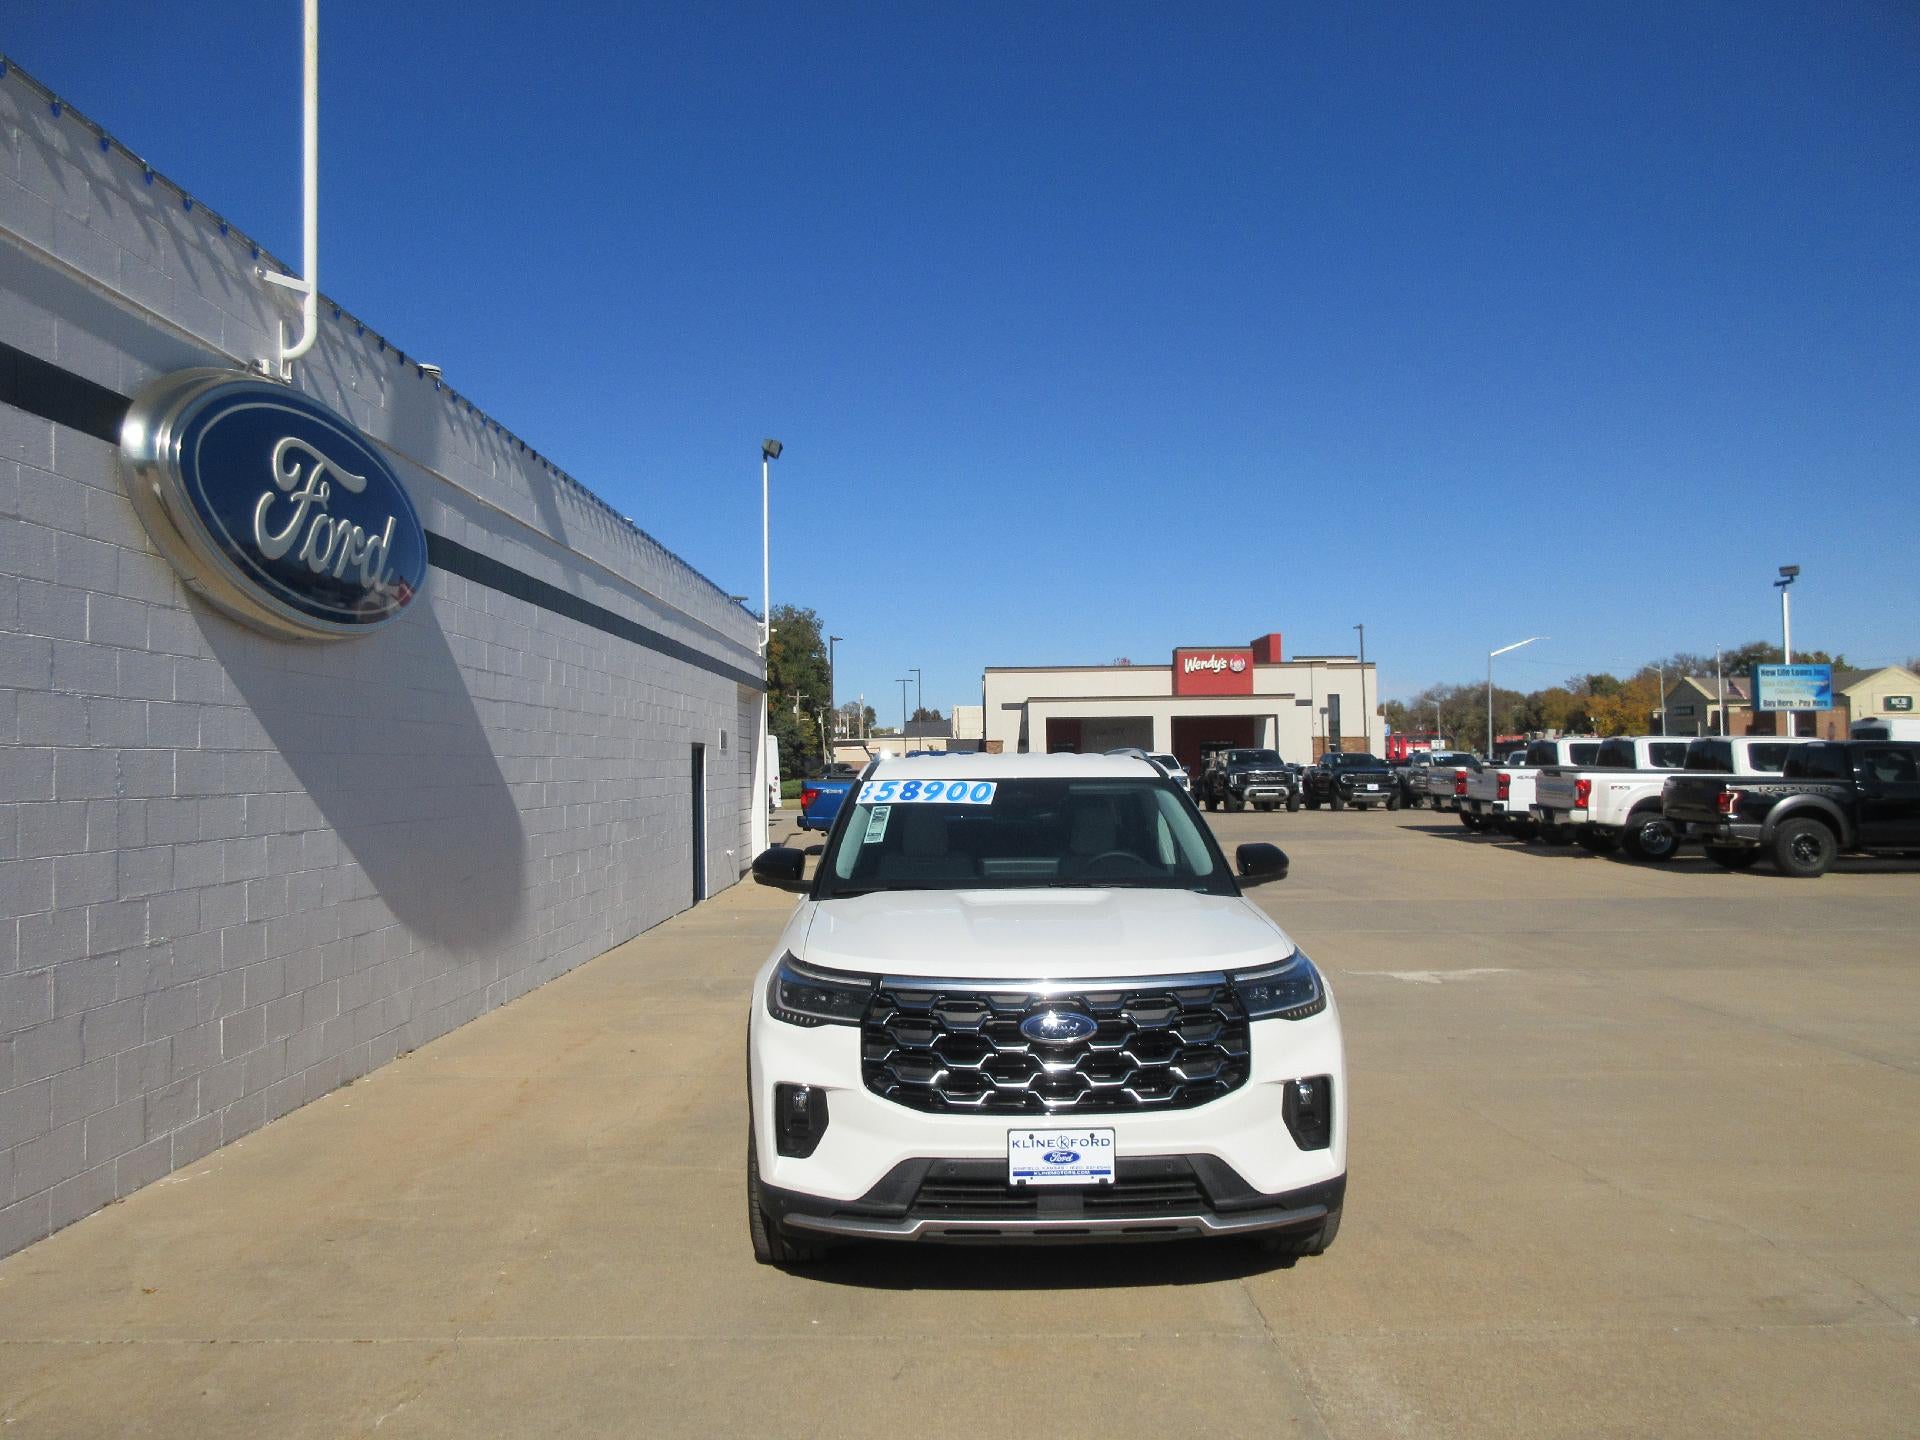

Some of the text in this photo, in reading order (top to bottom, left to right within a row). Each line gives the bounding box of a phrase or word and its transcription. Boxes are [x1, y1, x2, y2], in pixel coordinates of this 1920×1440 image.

[254, 436, 397, 592] Ford
[1184, 654, 1227, 673] Wendy's
[860, 780, 994, 802] $58900
[1012, 1139, 1056, 1149] KLINE
[1070, 1138, 1111, 1147] FORD
[1050, 1151, 1073, 1162] Ford
